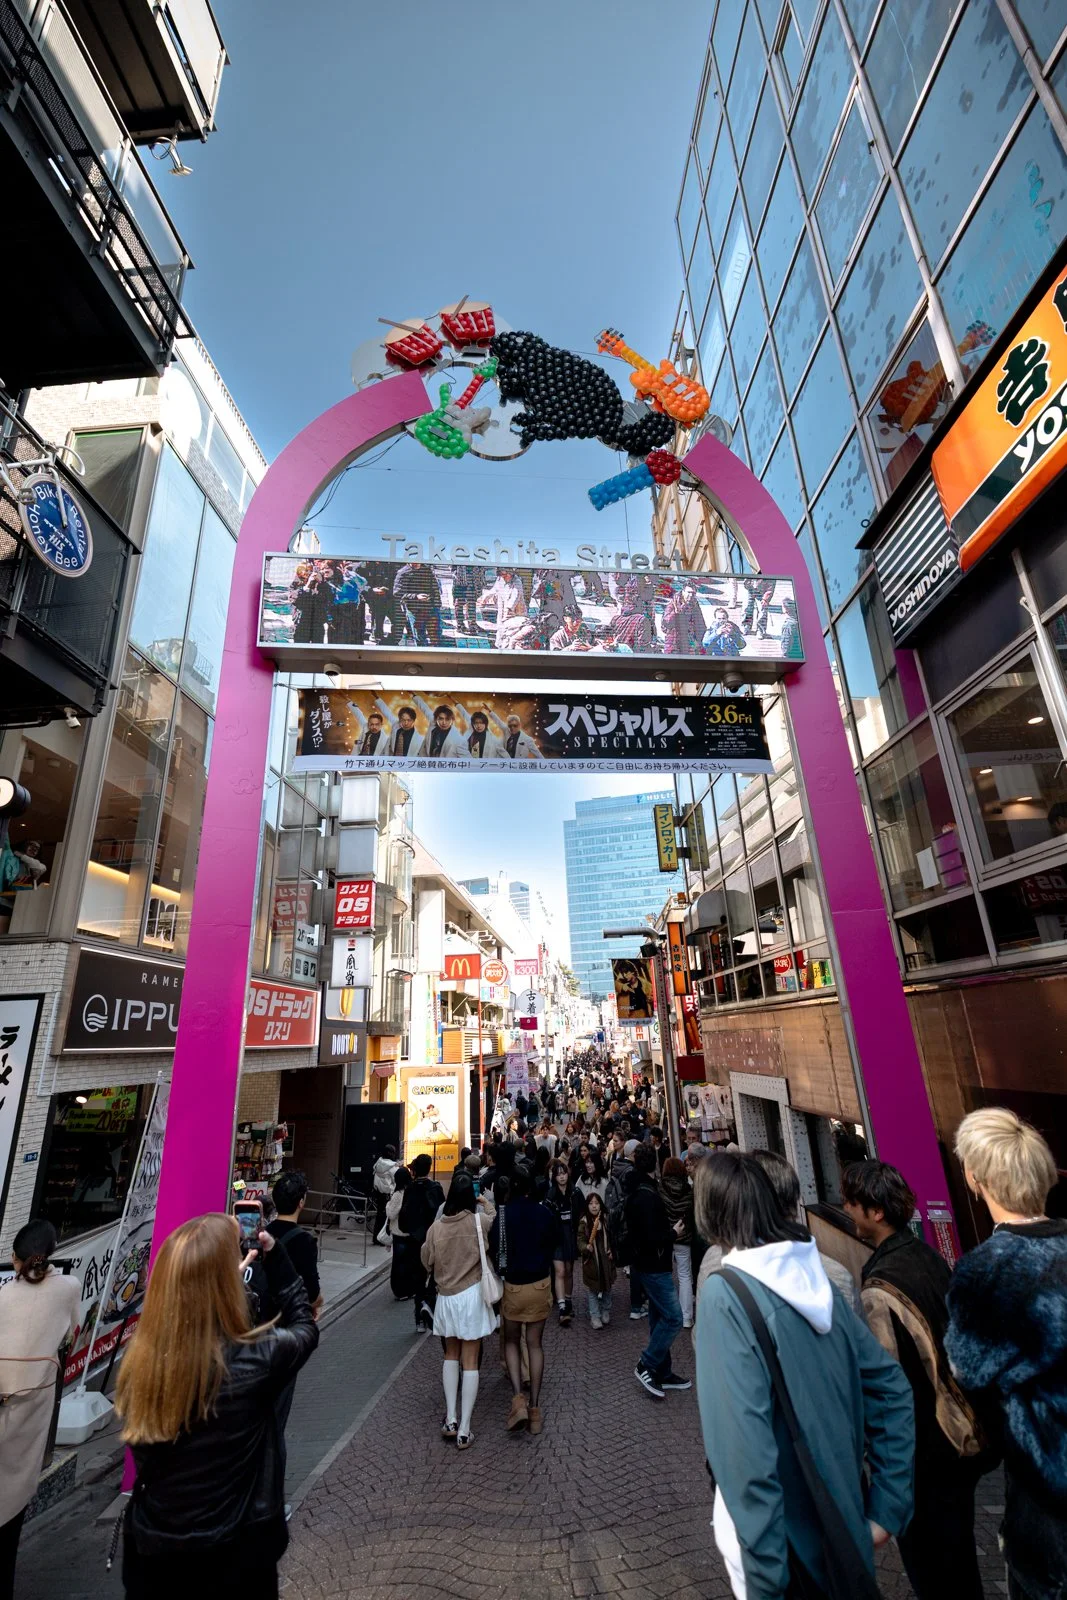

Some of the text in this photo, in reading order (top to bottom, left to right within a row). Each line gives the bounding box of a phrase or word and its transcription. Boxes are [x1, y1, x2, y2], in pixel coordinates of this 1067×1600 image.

[1013, 386, 1067, 474] YO
[55, 551, 78, 568] Bee
[381, 534, 684, 571] Takeshita Street
[889, 549, 956, 628] YOSHINOYA
[319, 695, 332, 729] 殺し屋が
[544, 704, 694, 736] スペシャルズ
[574, 736, 667, 749] SPECIALS
[659, 805, 674, 862] コインロッカー
[339, 884, 369, 895] クスリ
[337, 897, 370, 913] OS
[336, 915, 370, 925] ドラッグ
[141, 972, 183, 988] RAME
[525, 991, 537, 1014] 古着
[264, 1021, 291, 1041] クスリ
[0, 1025, 20, 1111] ラーメ
[411, 1085, 455, 1095] CAPCOM
